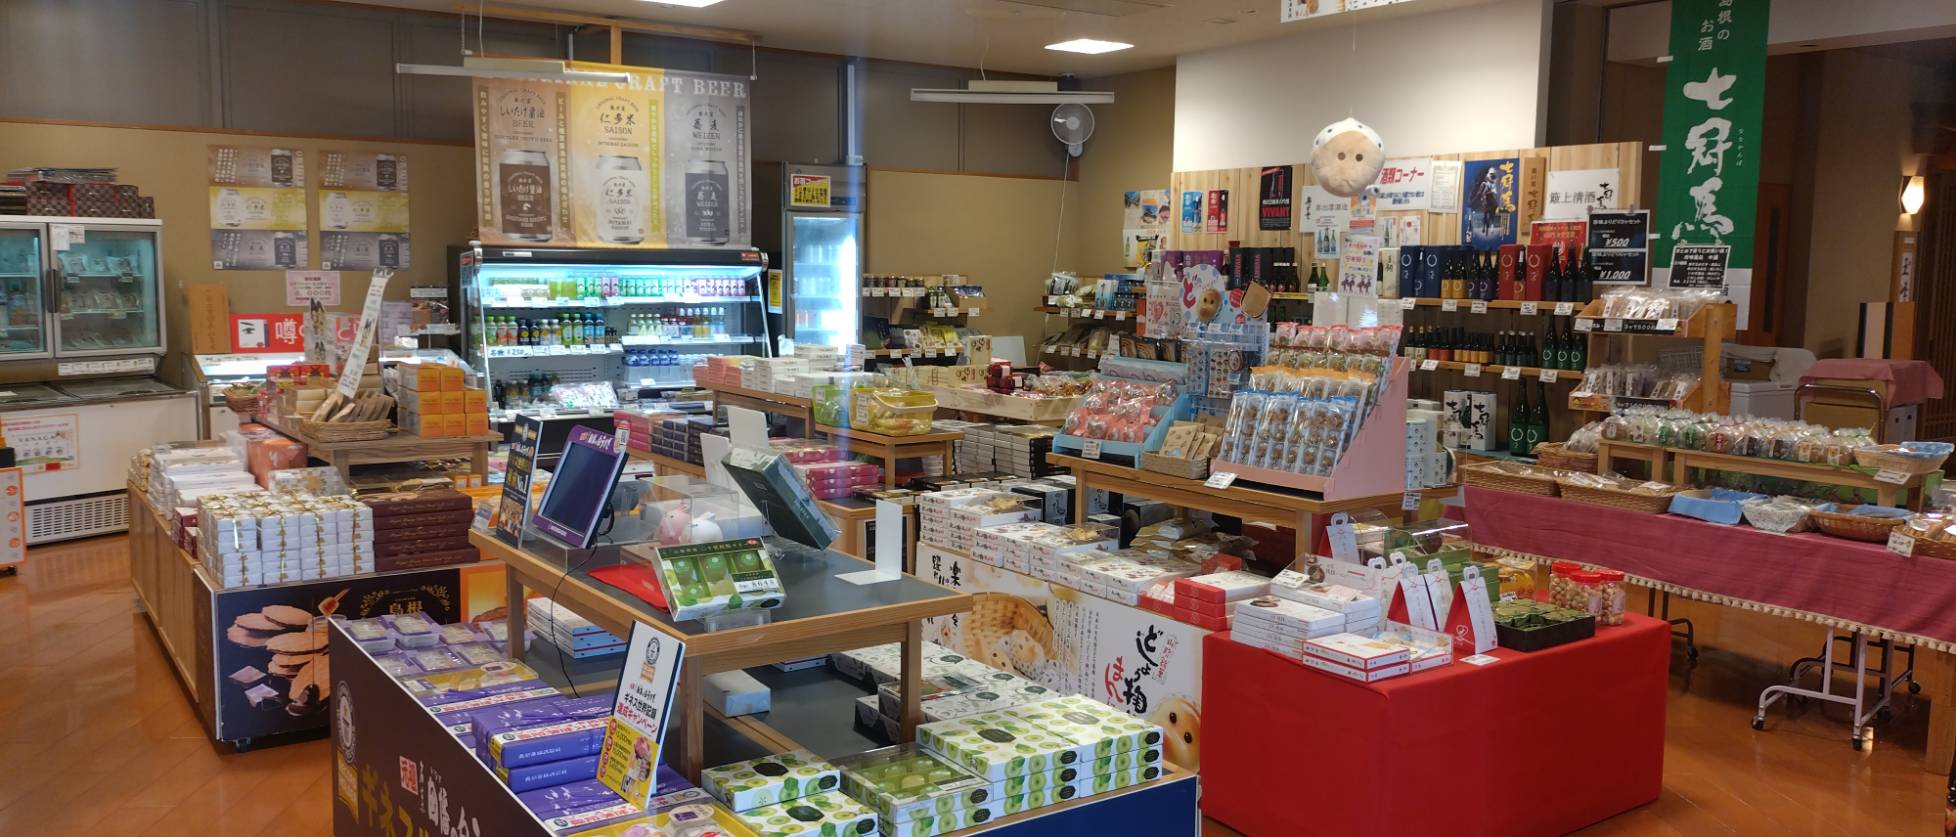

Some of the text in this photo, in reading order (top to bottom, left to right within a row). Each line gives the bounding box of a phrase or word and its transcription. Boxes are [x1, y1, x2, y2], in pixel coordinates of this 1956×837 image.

[1698, 19, 1714, 51] お酒
[694, 79, 746, 97] BEER
[600, 112, 636, 125] 仁多米
[604, 126, 633, 135] SAISON
[1671, 67, 1737, 240] 七冠馬
[1263, 207, 1289, 217] VIVANT
[1605, 238, 1630, 247] ¥500
[1600, 270, 1632, 280] ¥1,000
[624, 692, 658, 720] ギネス世界記録
[616, 702, 658, 734] 達成キャンペーン
